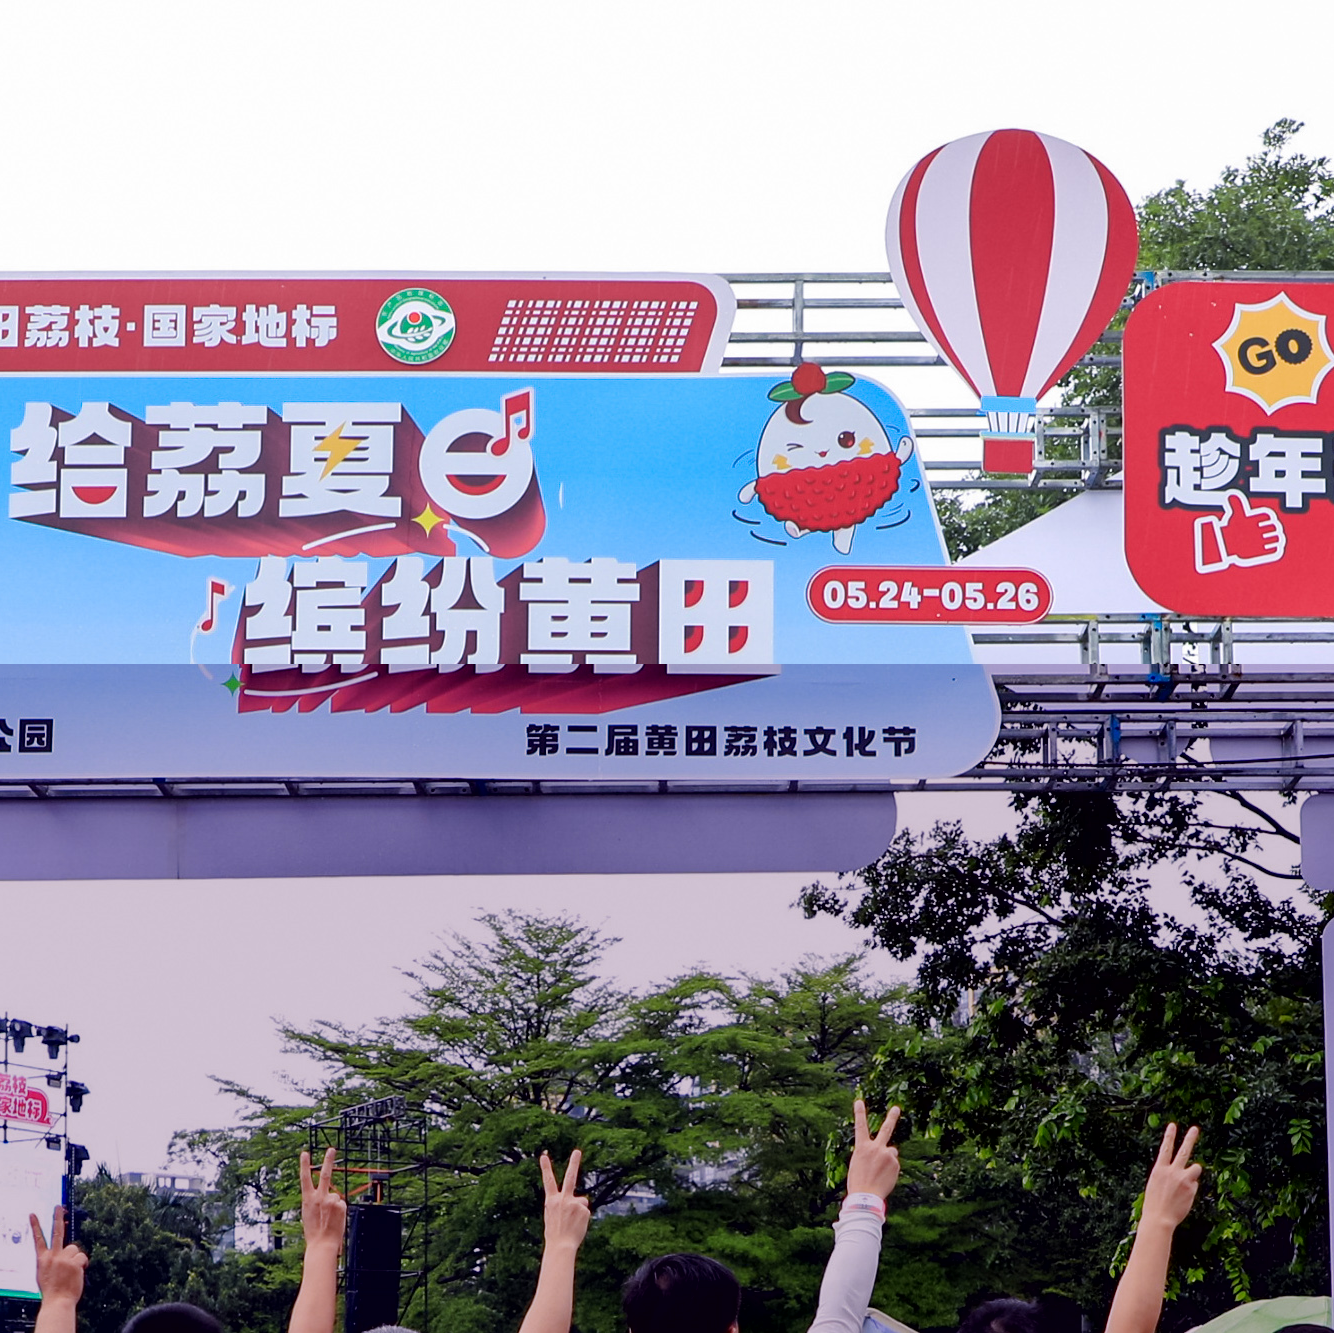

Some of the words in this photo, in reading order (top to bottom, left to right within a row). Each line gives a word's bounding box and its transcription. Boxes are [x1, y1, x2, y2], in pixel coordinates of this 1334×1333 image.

[1237, 328, 1313, 376] GO
[242, 558, 781, 675] 缤纷黄田
[822, 579, 1040, 615] 05.24-05.26
[525, 722, 918, 760] 第二届黄田荔枝文化节
